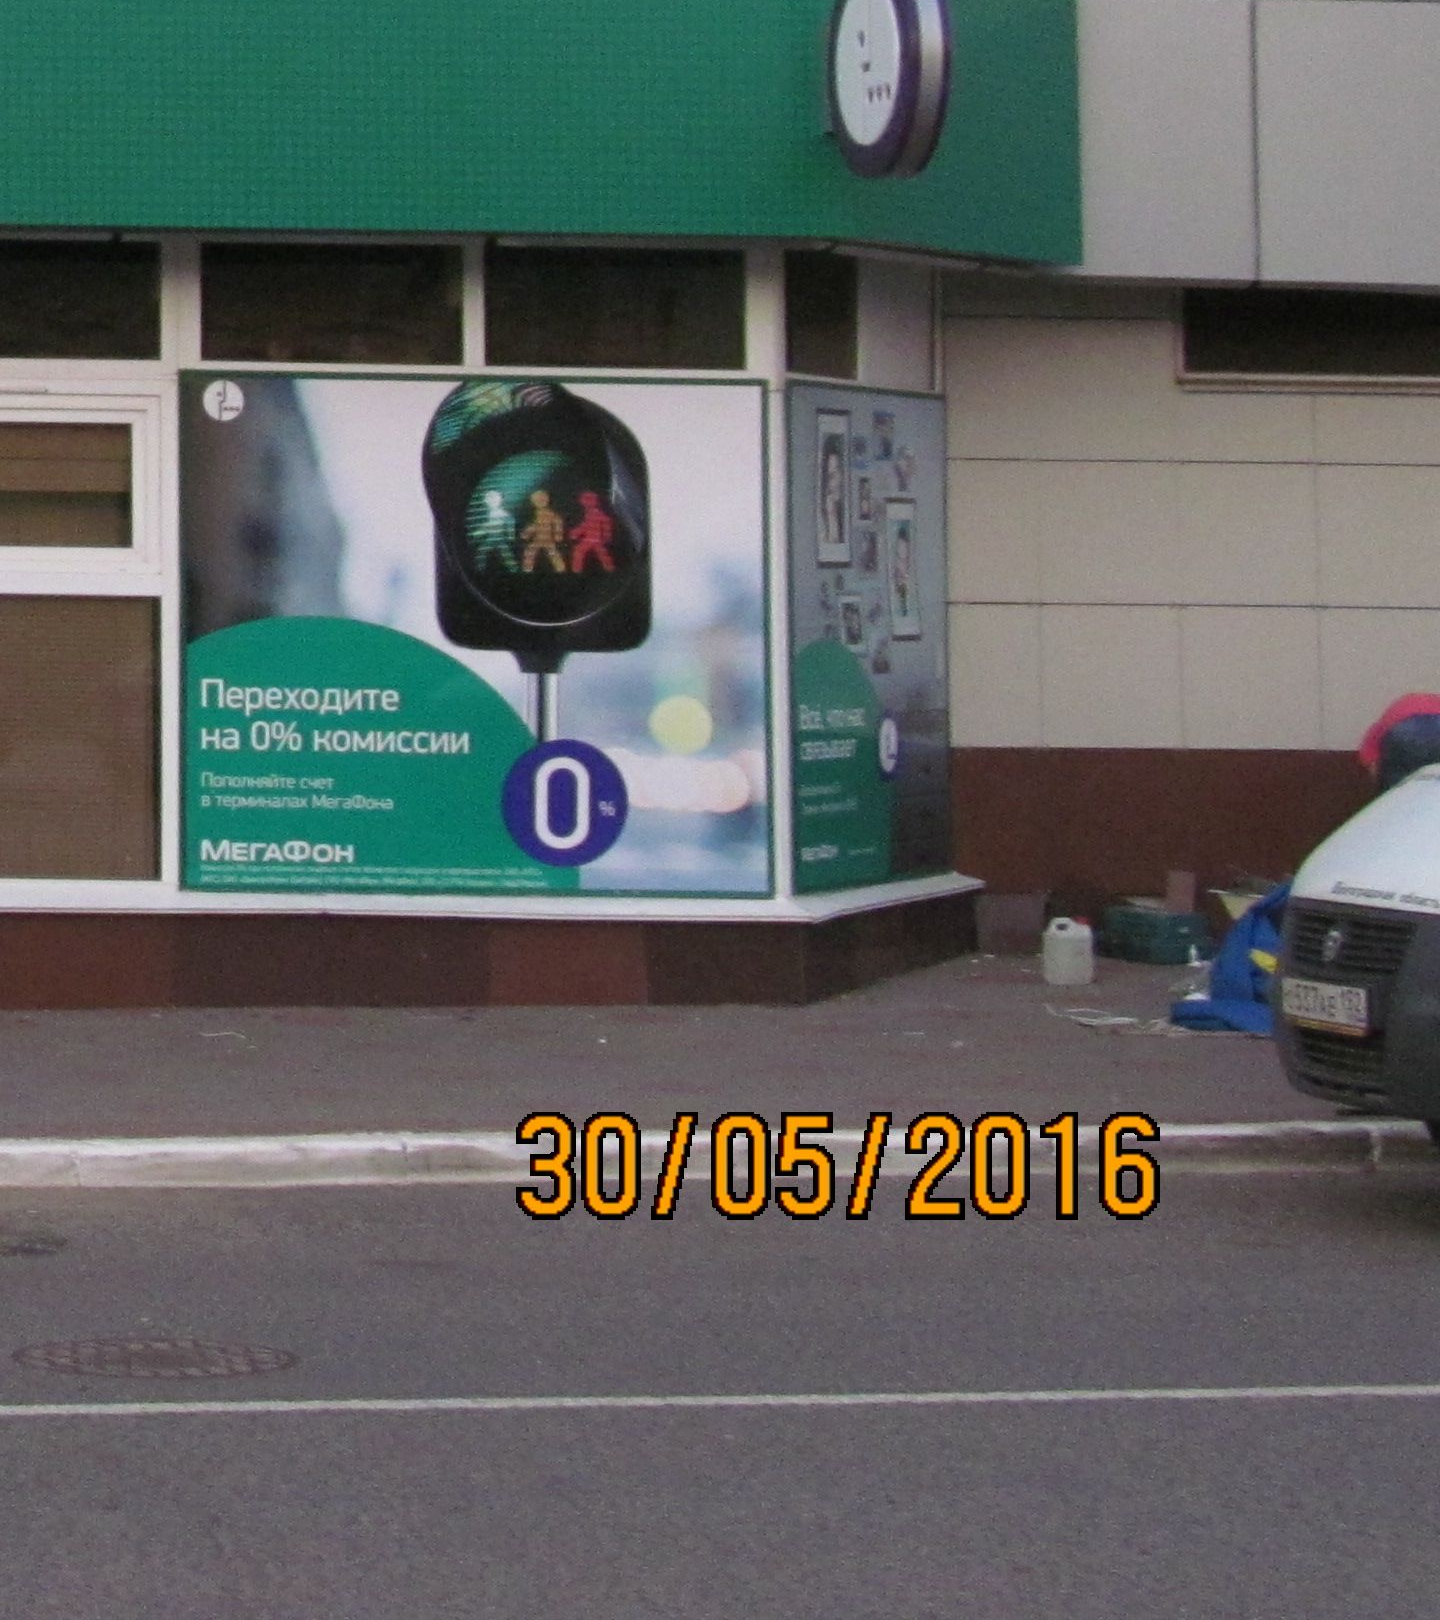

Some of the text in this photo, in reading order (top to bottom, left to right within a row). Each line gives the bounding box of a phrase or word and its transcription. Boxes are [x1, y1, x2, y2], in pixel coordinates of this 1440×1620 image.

[200, 678, 401, 716] Переходите
[200, 720, 471, 755] на 0% комиссии
[201, 771, 297, 790] Пополняйте
[200, 794, 212, 808] в
[214, 794, 309, 811] терминалах
